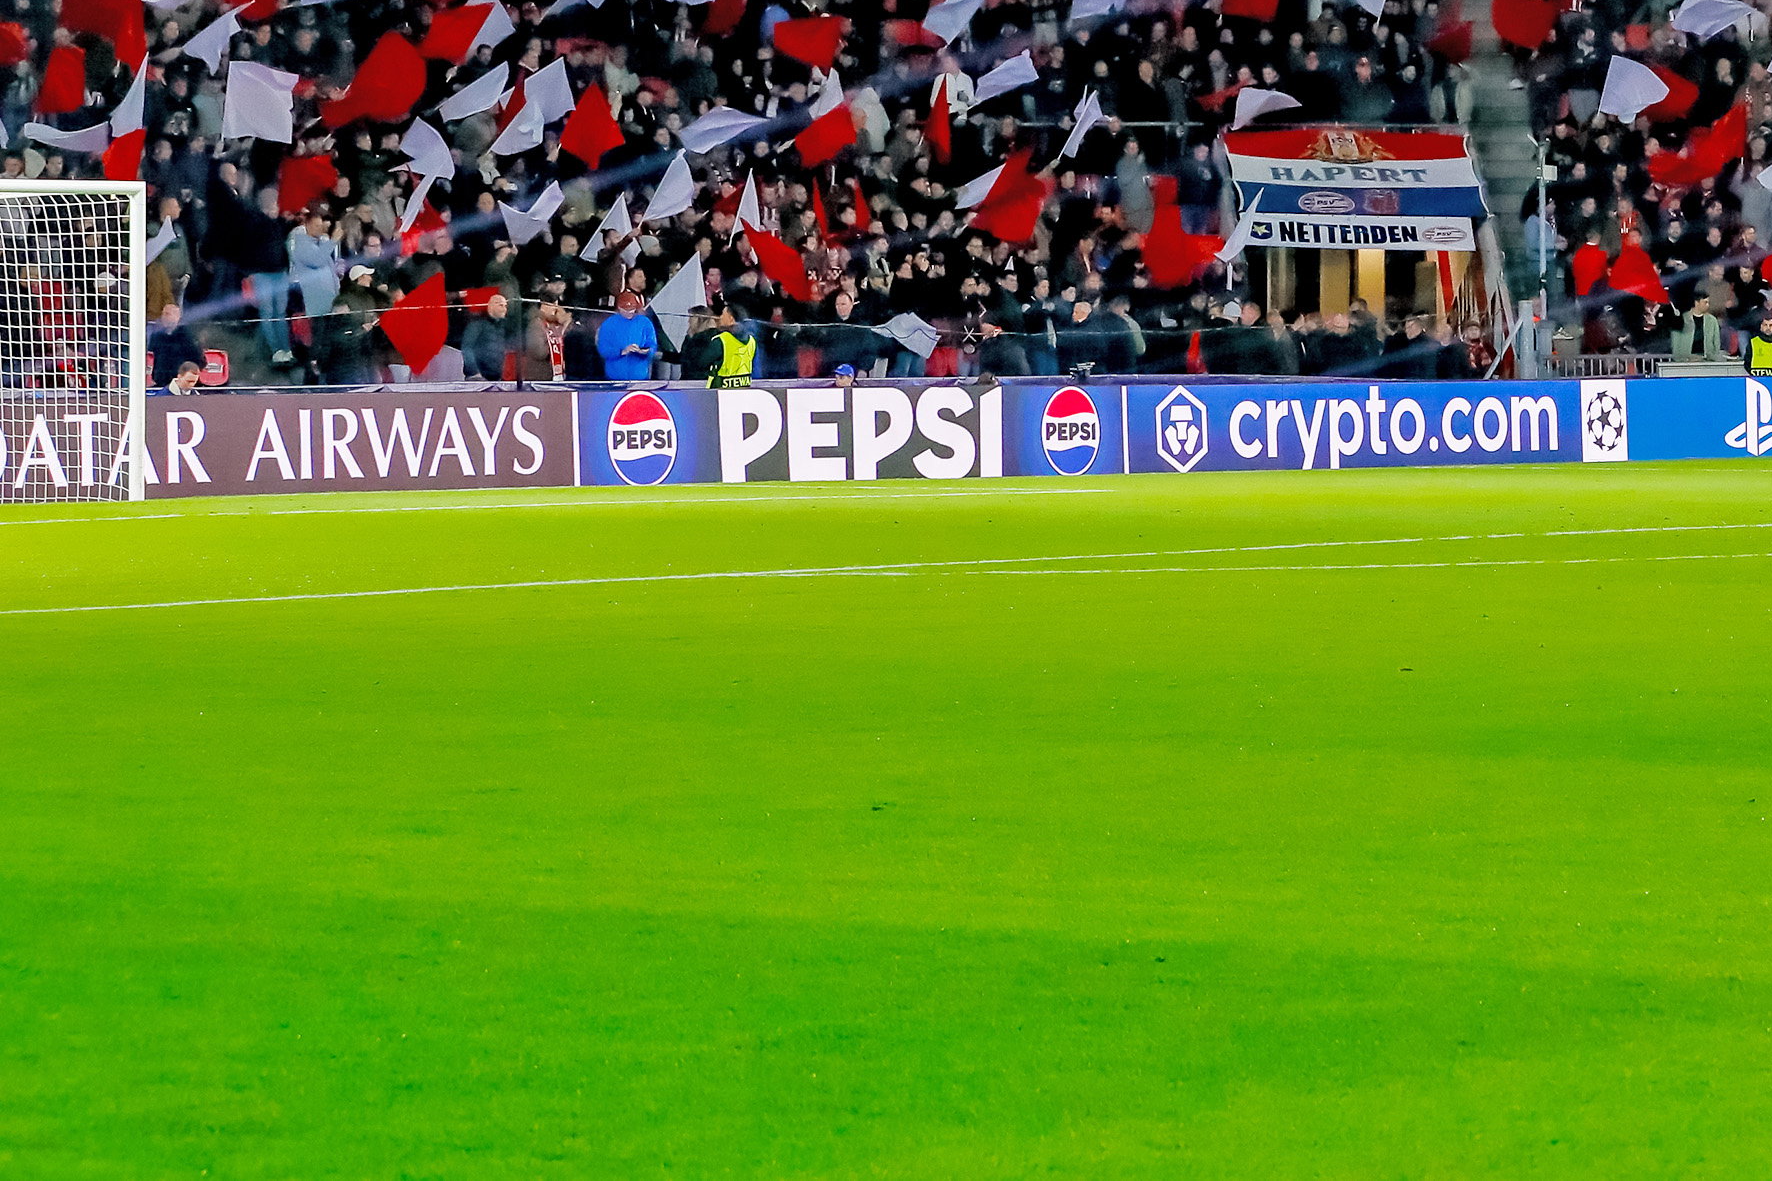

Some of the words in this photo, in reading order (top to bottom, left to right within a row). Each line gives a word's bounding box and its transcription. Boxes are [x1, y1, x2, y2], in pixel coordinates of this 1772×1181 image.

[1270, 165, 1428, 183] HAPERT
[1280, 222, 1418, 244] NETTERDEN
[717, 385, 1003, 483] PEPSI
[1045, 421, 1096, 441] PEPSI
[1228, 385, 1559, 470] crypto.com
[0, 411, 212, 489] ATAR
[245, 404, 545, 482] AIRWAYS
[612, 429, 673, 451] PEPSI
